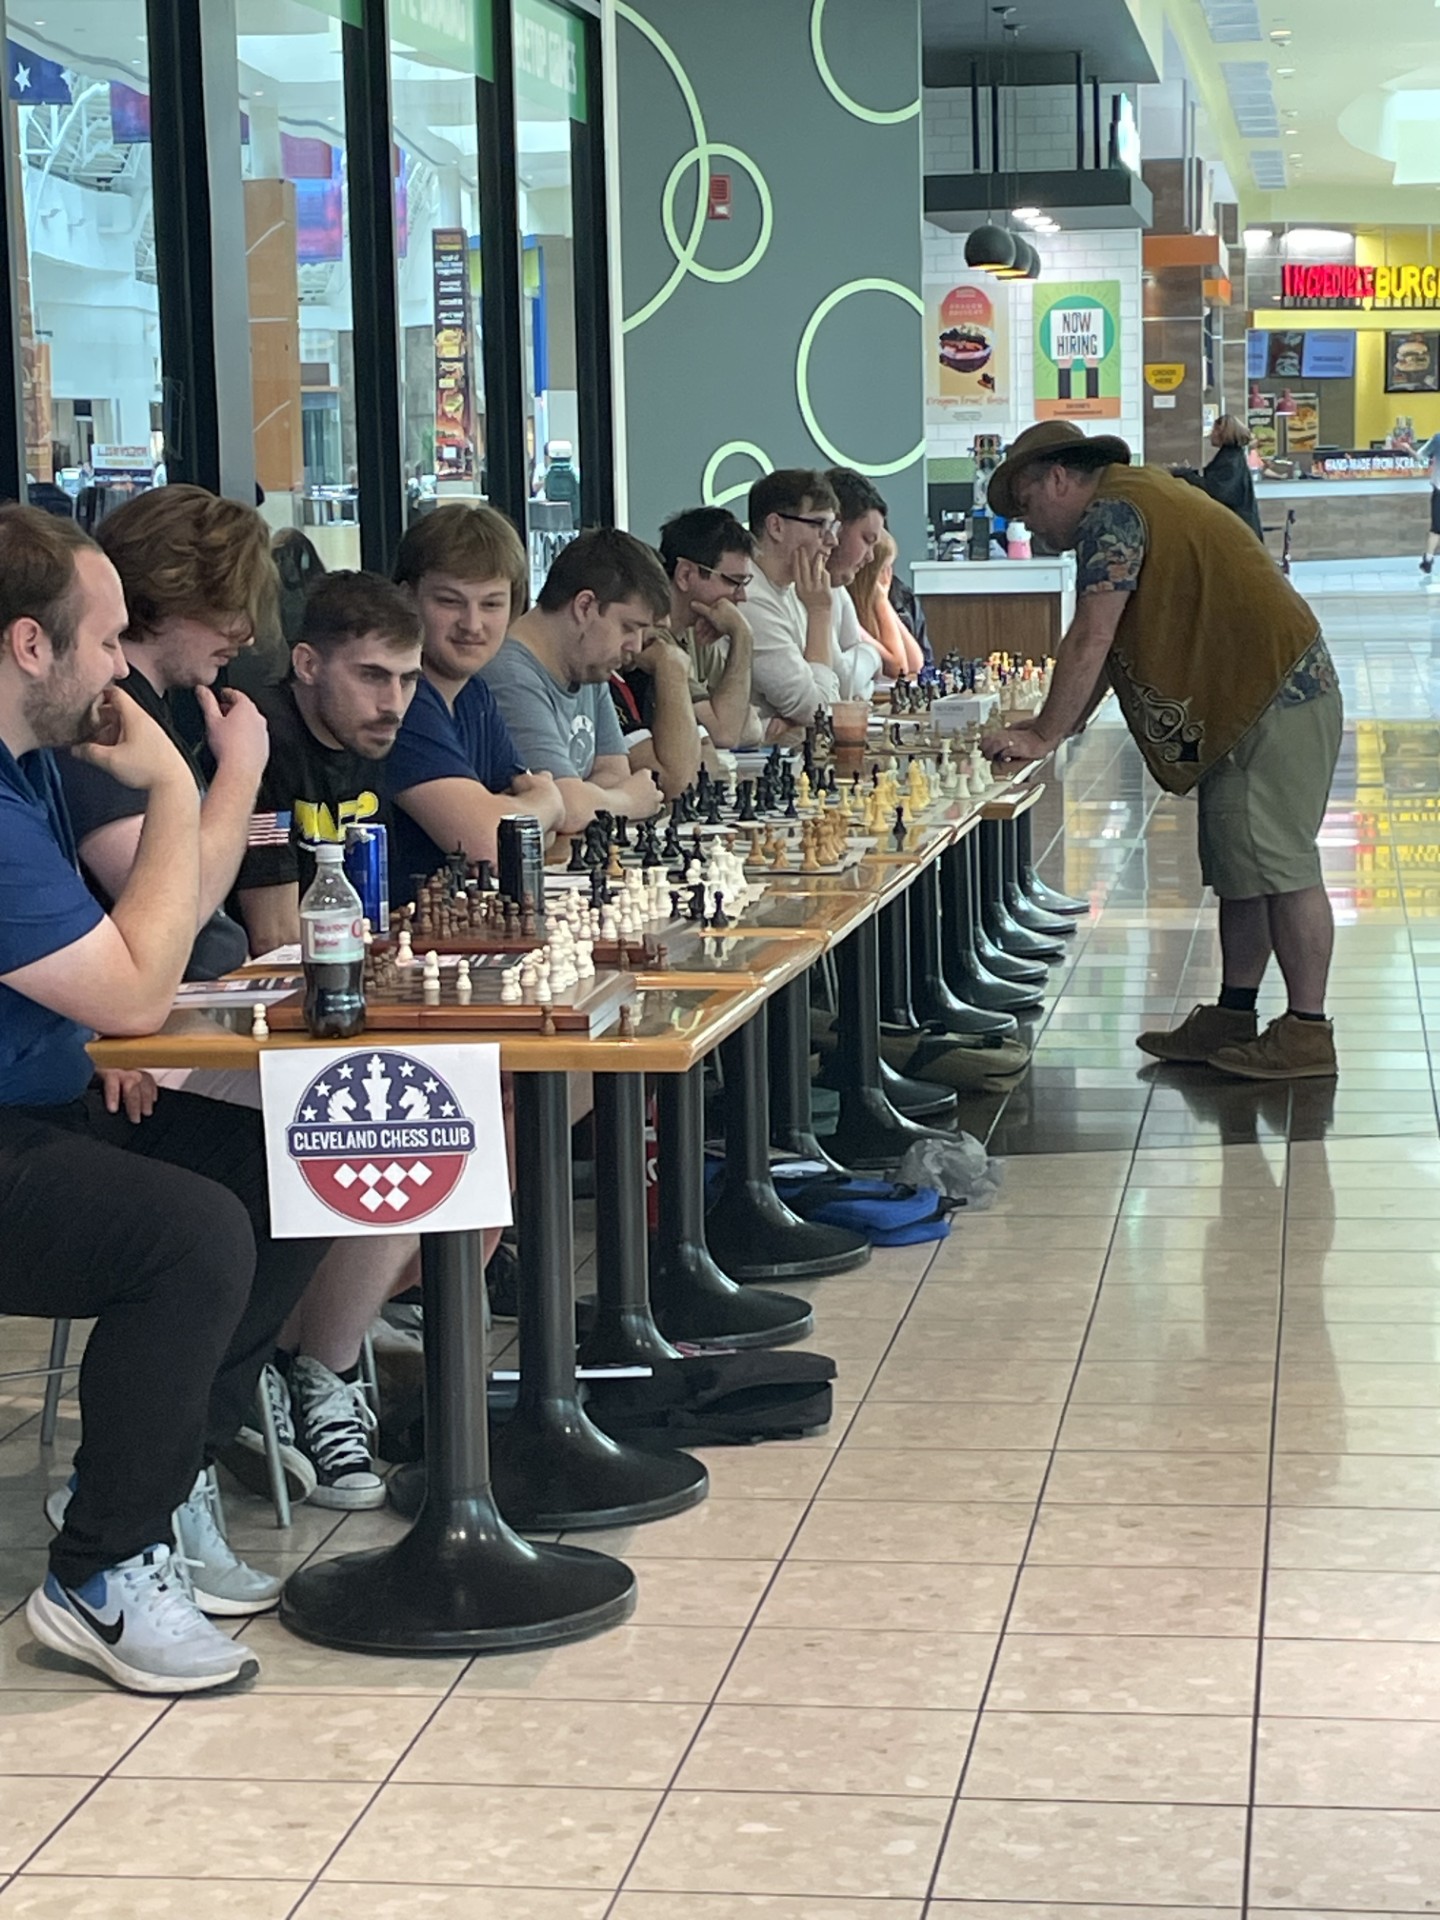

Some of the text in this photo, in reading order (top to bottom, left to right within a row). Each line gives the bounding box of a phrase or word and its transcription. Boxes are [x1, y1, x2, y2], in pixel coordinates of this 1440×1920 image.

[1284, 263, 1440, 299] INCREDIBLE BURG
[1062, 311, 1092, 333] NOW
[1057, 334, 1098, 356] HIRING
[1395, 456, 1429, 470] SCRACH
[293, 1126, 471, 1151] CLEVELAND CHESS CLUB
